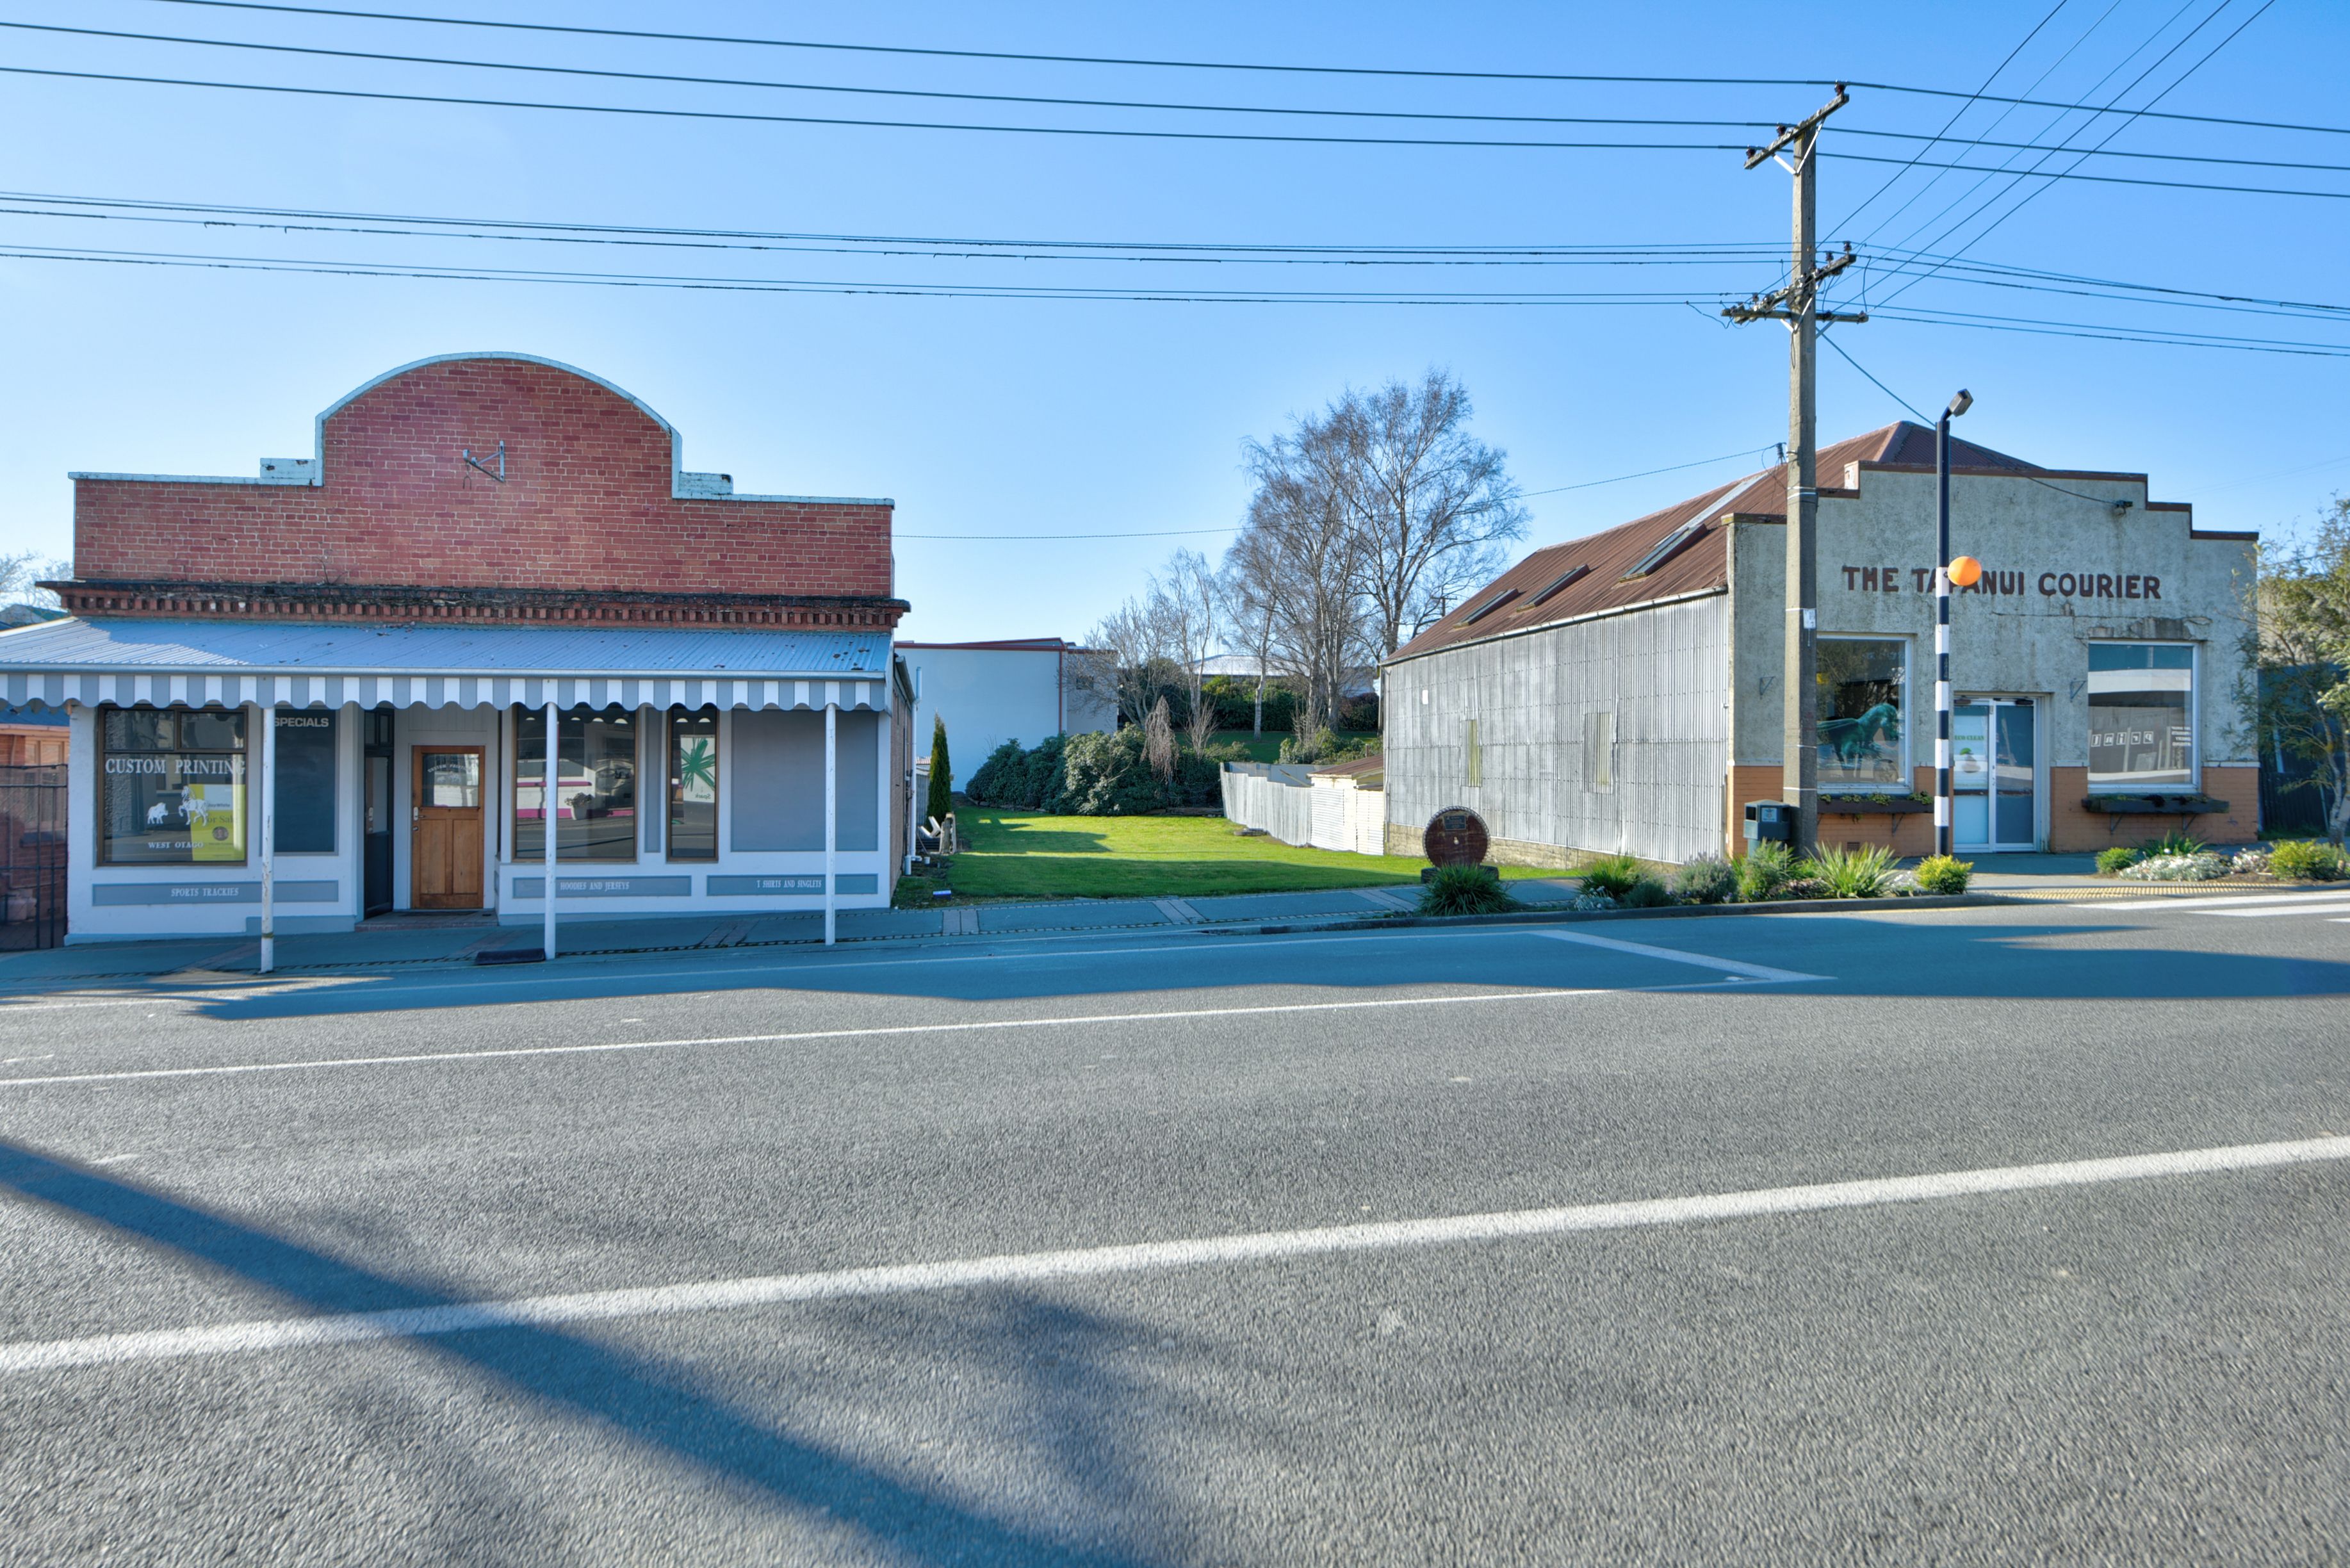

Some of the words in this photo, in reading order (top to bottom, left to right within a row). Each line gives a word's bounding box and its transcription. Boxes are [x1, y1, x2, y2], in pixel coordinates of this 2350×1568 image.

[1842, 565, 1899, 592] THE
[1911, 568, 2024, 595] TNUI
[2038, 572, 2161, 599] COURIER
[275, 717, 329, 727] SPECIALS
[105, 758, 166, 774] CUSTOM
[175, 760, 245, 775] PRINTING
[560, 881, 587, 890] HOODIES
[589, 881, 603, 890] AND
[605, 881, 630, 892] JERSEYS
[171, 888, 199, 897] SPORTS
[202, 888, 239, 896] TRACKIES
